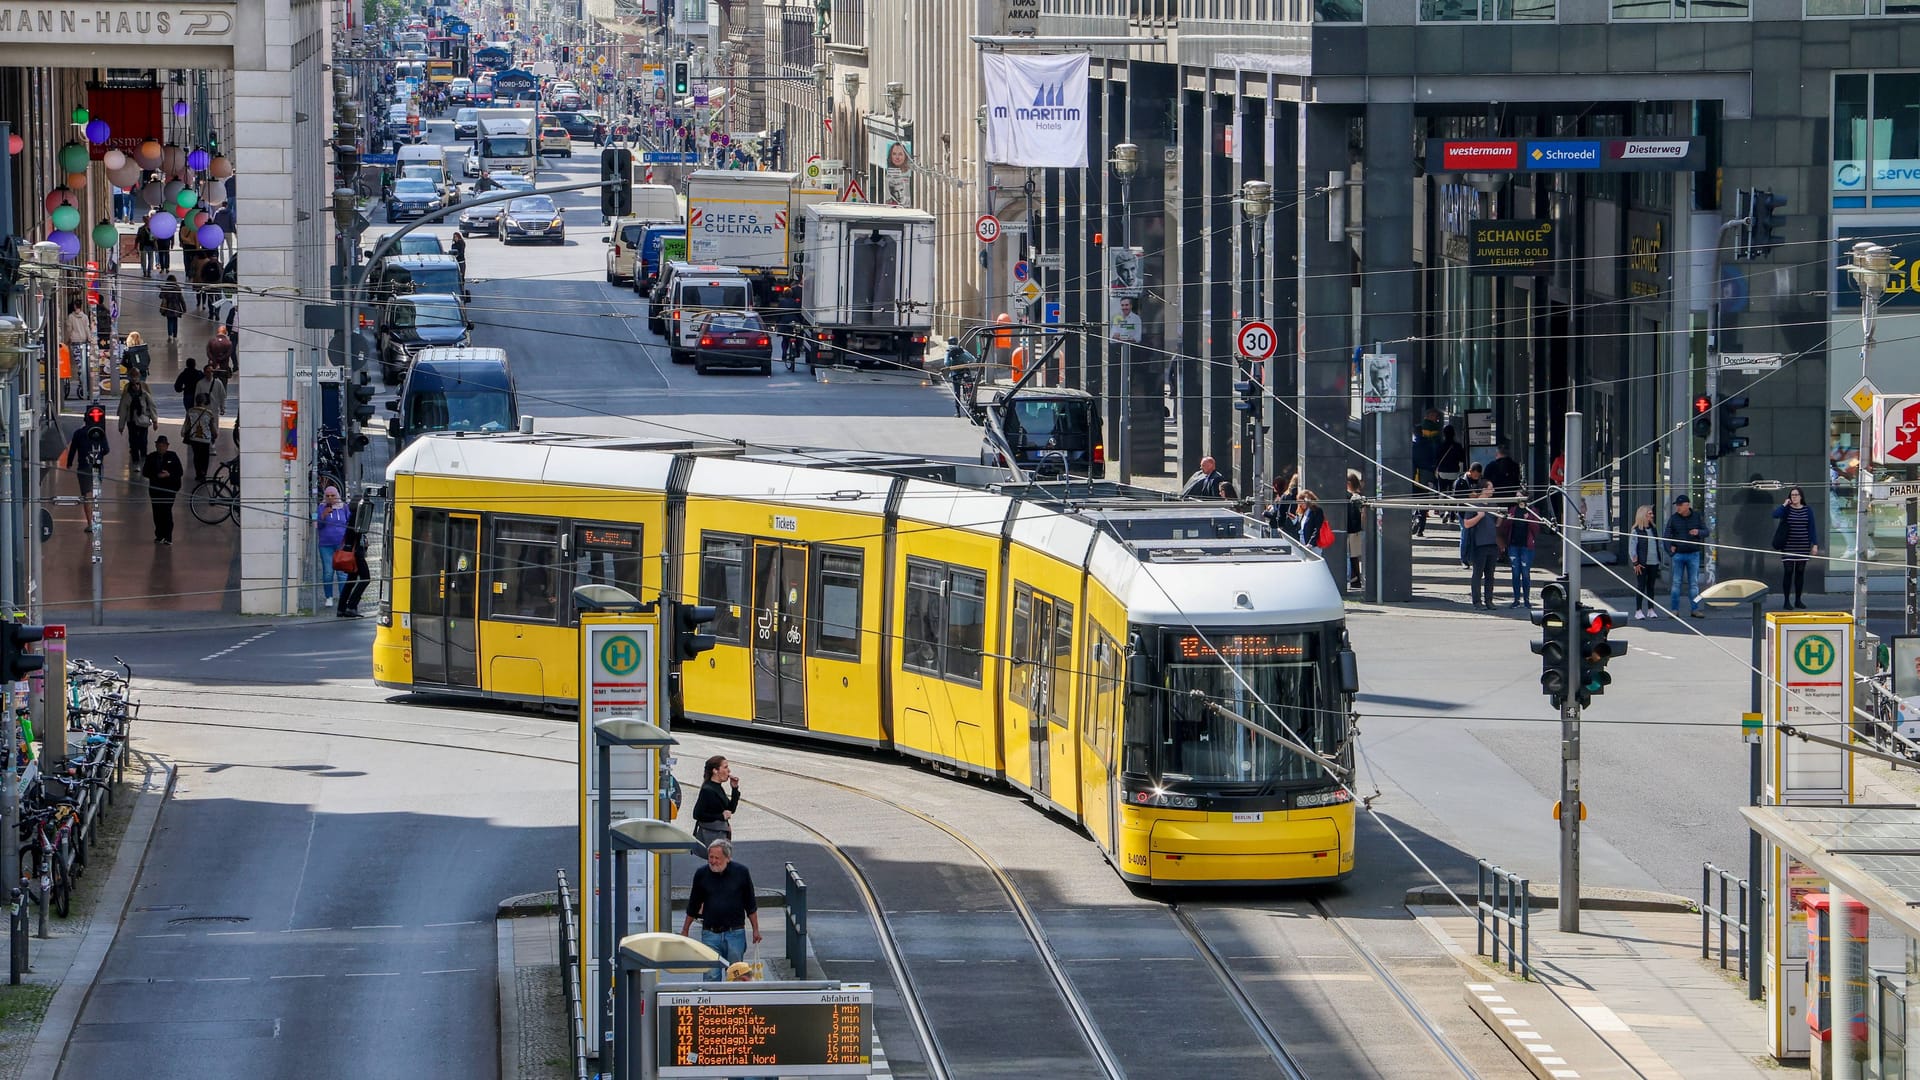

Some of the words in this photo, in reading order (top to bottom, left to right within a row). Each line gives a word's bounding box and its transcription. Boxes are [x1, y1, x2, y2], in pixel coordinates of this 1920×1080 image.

[498, 80, 531, 89] NORD-SÜD
[1016, 108, 1080, 120] MARITIM
[1035, 122, 1062, 130] Hotels
[1449, 147, 1513, 156] westermann
[1545, 149, 1596, 160] Schroedel
[1628, 144, 1681, 155] Diesterweg
[704, 213, 757, 224] CHEFS
[704, 223, 773, 235] CULINAR
[981, 222, 996, 236] 30
[1477, 248, 1520, 256] JUWELIER
[1525, 248, 1549, 256] GOLD
[1246, 333, 1267, 350] 30
[1890, 485, 1920, 496] PHARM
[775, 516, 796, 530] Tickets
[611, 645, 631, 667] H
[1805, 644, 1825, 666] H
[697, 996, 711, 1004] Ziel
[677, 1006, 693, 1015] M1
[698, 1005, 754, 1015] Schillerstr.
[832, 1004, 839, 1014] 1
[841, 1004, 860, 1013] min
[677, 1016, 693, 1025] 12
[698, 1015, 766, 1026] Pasedagplatz
[832, 1014, 839, 1024] 5
[841, 1014, 860, 1023] min
[677, 1026, 693, 1035] M1
[698, 1025, 749, 1035] Rosenthal
[752, 1025, 776, 1035] Nord
[832, 1023, 839, 1033] 9
[841, 1023, 860, 1032] min
[677, 1036, 693, 1045] 12
[698, 1035, 766, 1046] Pasedagplatz
[827, 1033, 839, 1043] 15
[841, 1033, 860, 1042] min
[698, 1045, 754, 1055] Schillerstr.
[827, 1043, 839, 1053] 16
[841, 1043, 860, 1052] min
[698, 1054, 749, 1064] Rosenthal
[752, 1054, 776, 1064] Nord
[827, 1053, 839, 1063] 24
[841, 1053, 860, 1062] min
